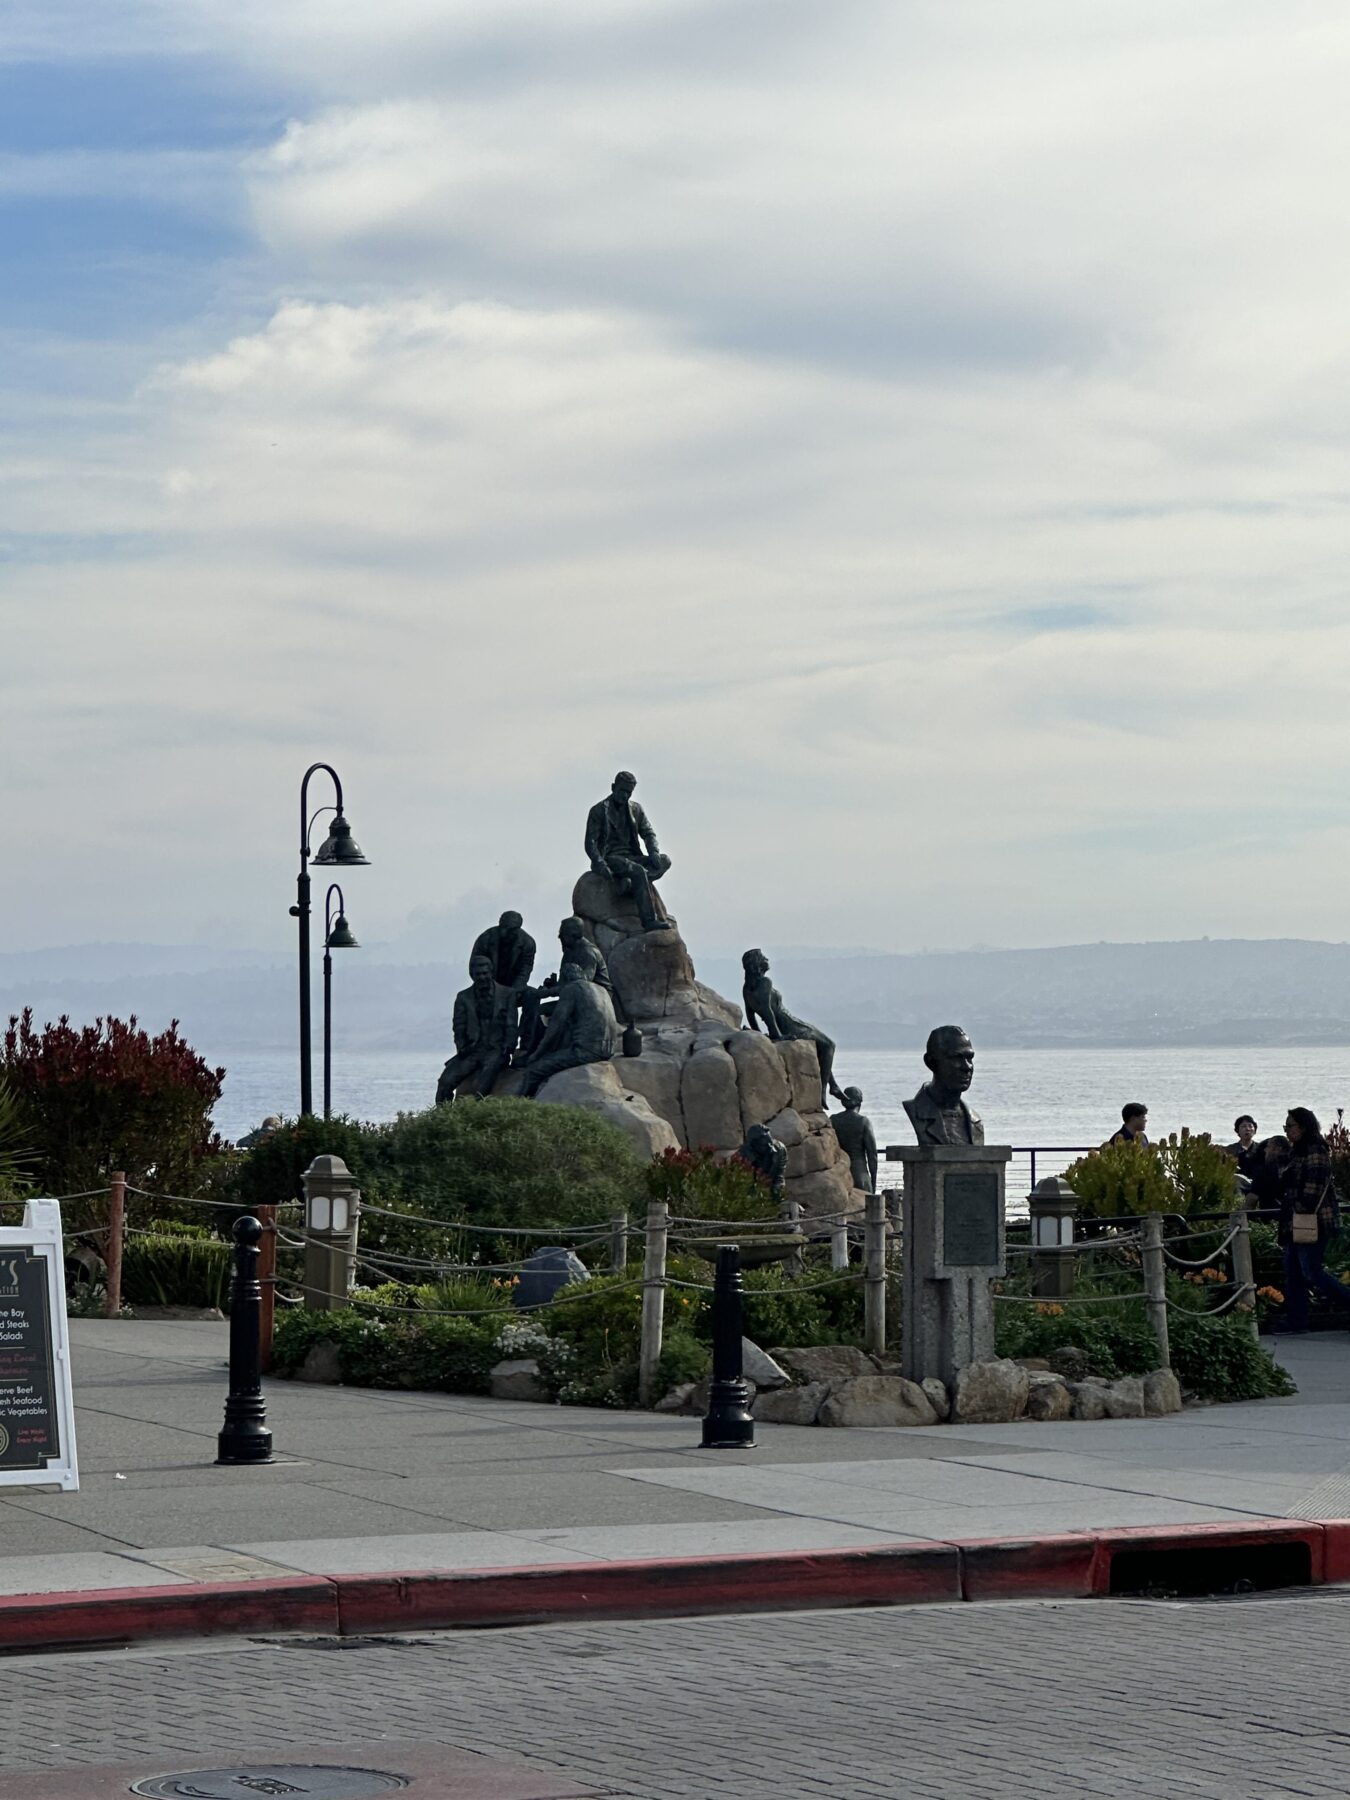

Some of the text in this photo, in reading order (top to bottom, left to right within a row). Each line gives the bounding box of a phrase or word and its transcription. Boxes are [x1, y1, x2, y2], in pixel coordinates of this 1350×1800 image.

[0, 1286, 19, 1294] TION
[11, 1308, 25, 1318] Bay
[7, 1320, 29, 1329] Steaks
[0, 1331, 23, 1340] Salads
[17, 1386, 33, 1394] Beef
[13, 1395, 43, 1405] Seafood
[7, 1406, 48, 1418] Vegetables
